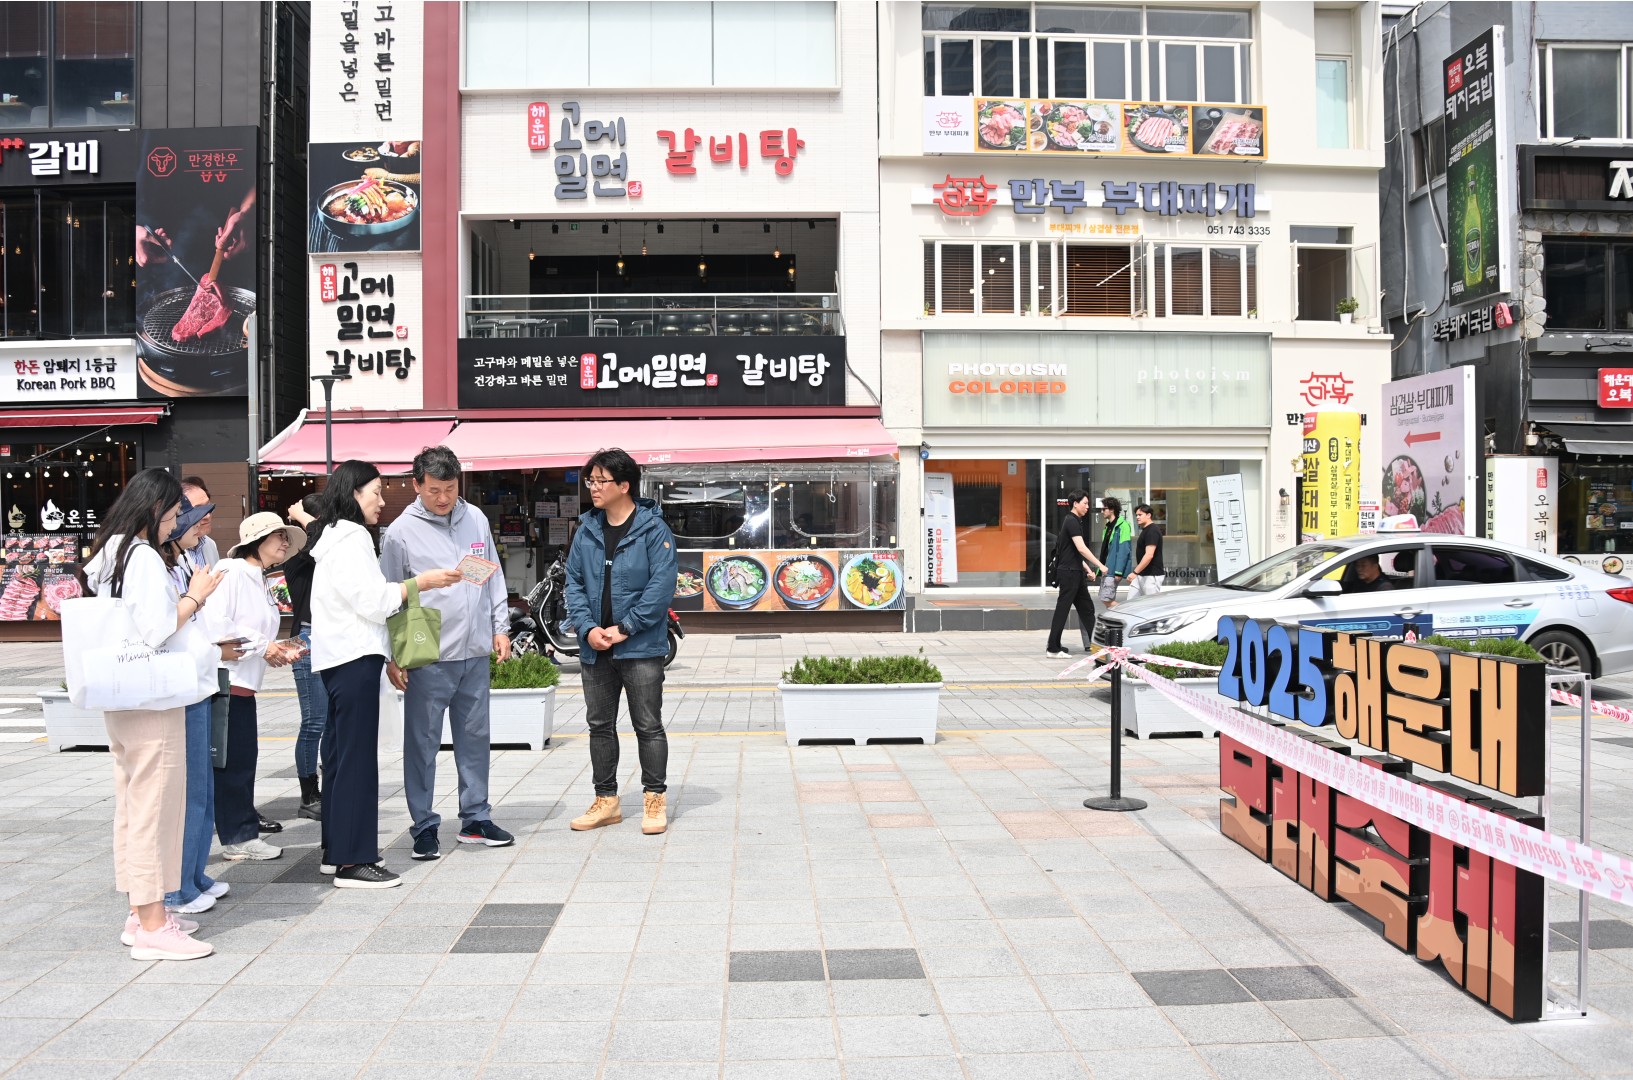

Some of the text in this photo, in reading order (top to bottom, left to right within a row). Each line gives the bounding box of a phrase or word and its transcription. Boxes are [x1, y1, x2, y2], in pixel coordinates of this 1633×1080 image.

[373, 0, 396, 122] 고 바른 밀면
[1464, 43, 1488, 75] 오복
[339, 58, 359, 102] 넣은
[1446, 72, 1493, 120] 돼지국밥
[529, 104, 547, 148] 해운대
[554, 102, 626, 149] 고메
[28, 140, 99, 176] 갈비
[189, 152, 239, 168] 만경한우
[656, 128, 806, 176] 갈비탕
[554, 152, 628, 200] 밀면
[1008, 178, 1257, 218] 만부 부대찌개
[1207, 225, 1271, 236] 051 743 3335
[321, 265, 336, 300] 해운대
[337, 262, 395, 301] 고메
[336, 303, 396, 341] 밀면
[1432, 305, 1493, 342] 오복돼지국밥
[14, 357, 117, 376] 한돈 암퇘지 1등급
[325, 347, 416, 380] 갈비탕
[474, 356, 580, 369] 고구마와 메밀을 넣은
[582, 355, 595, 388] 해운대
[597, 352, 707, 389] 고메밀면
[736, 352, 831, 388] 갈비탕
[949, 363, 1067, 376] PHOTOISM
[1136, 364, 1251, 384] photoism
[17, 376, 116, 391] Korean Pork BBQ
[474, 375, 568, 387] 건강하고 바른 밀면
[949, 380, 1067, 395] COLORED
[1169, 384, 1219, 394] BOX
[1604, 374, 1633, 387] 해운대
[1606, 387, 1633, 402] 오복
[1560, 591, 1590, 600] 5530
[1218, 615, 1521, 797] 2025 해운대
